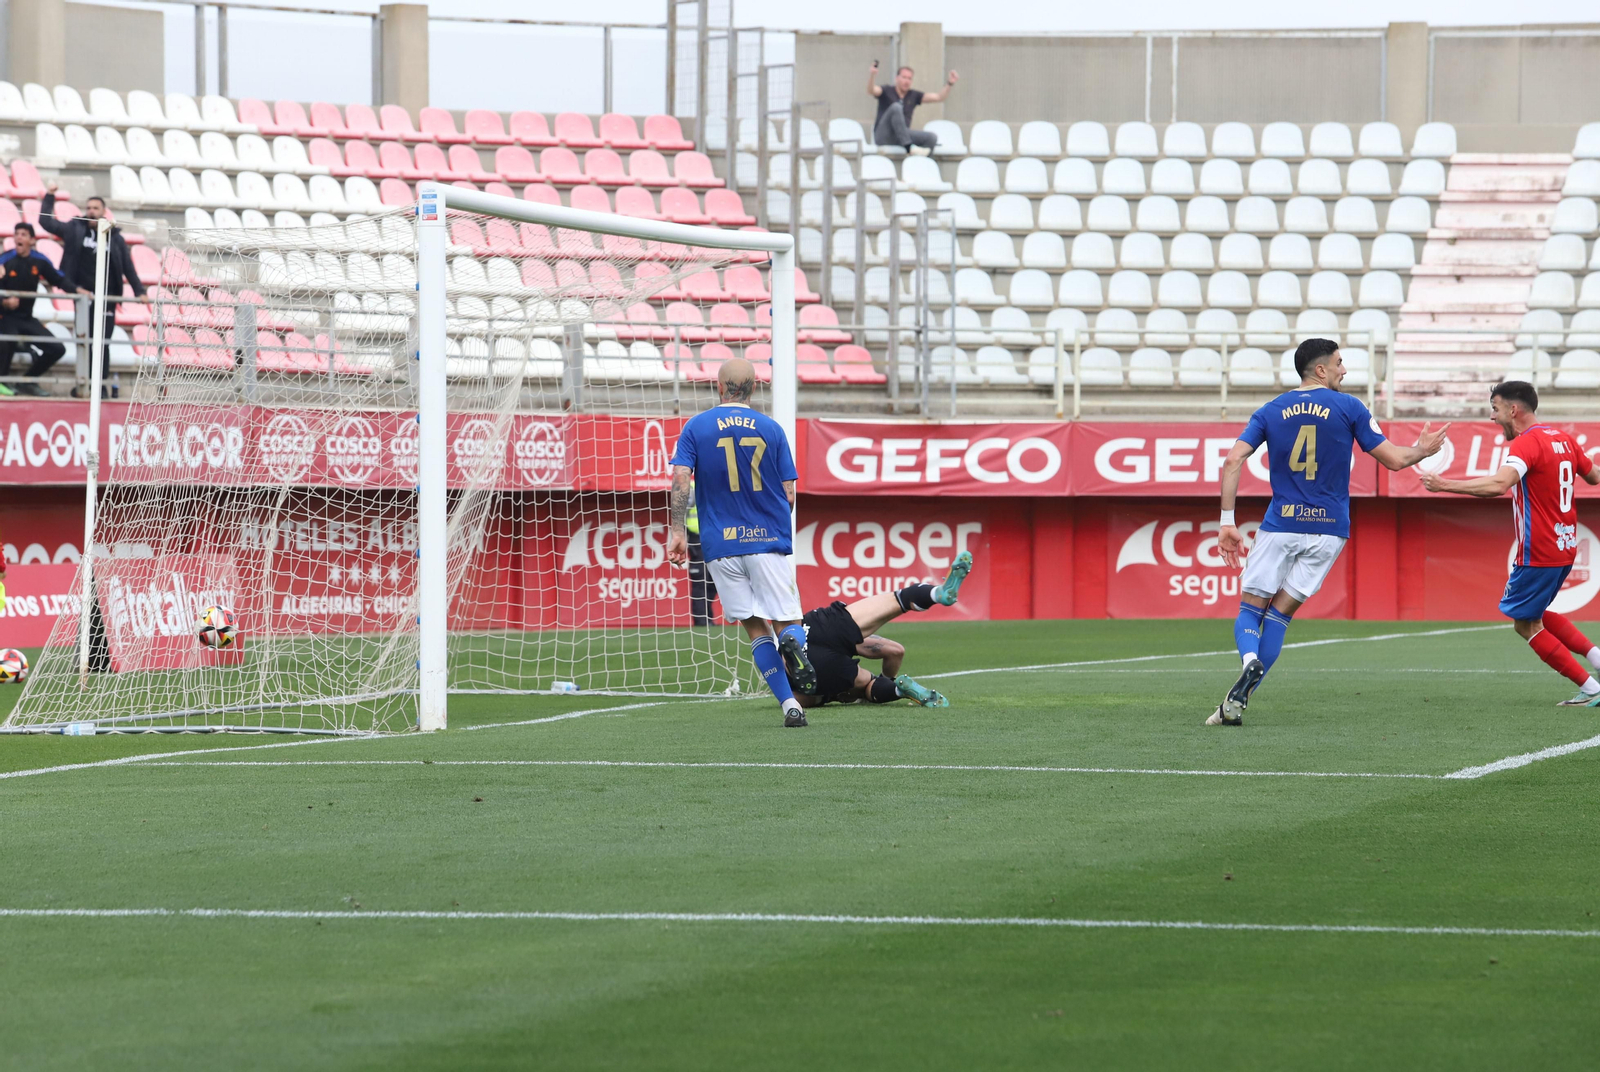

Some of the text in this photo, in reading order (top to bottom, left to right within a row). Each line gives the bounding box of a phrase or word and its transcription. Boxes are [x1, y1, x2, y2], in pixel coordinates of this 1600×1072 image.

[1282, 402, 1331, 420] MOLINA
[717, 416, 757, 431] ÁNGEL
[0, 420, 91, 468] ACOR
[108, 422, 244, 468] RECACOR
[259, 436, 316, 453] COSCO
[326, 437, 381, 454] COSCO
[390, 438, 419, 456] COS
[515, 441, 566, 458] COSCO
[1288, 424, 1318, 480] 4
[328, 456, 380, 467] SHIPPING
[517, 459, 564, 470] SHIPPING
[716, 436, 767, 492] 17
[826, 437, 1062, 483] GEFCO
[1559, 460, 1574, 513] 8
[1296, 504, 1326, 517] Jaén
[240, 517, 359, 551] HOTELES
[738, 525, 768, 538] Jaén
[821, 521, 982, 569] caser
[599, 577, 677, 608] seguros
[1169, 574, 1243, 605] segu
[0, 594, 40, 618] TOS
[281, 596, 362, 614] ALGECIRAS
